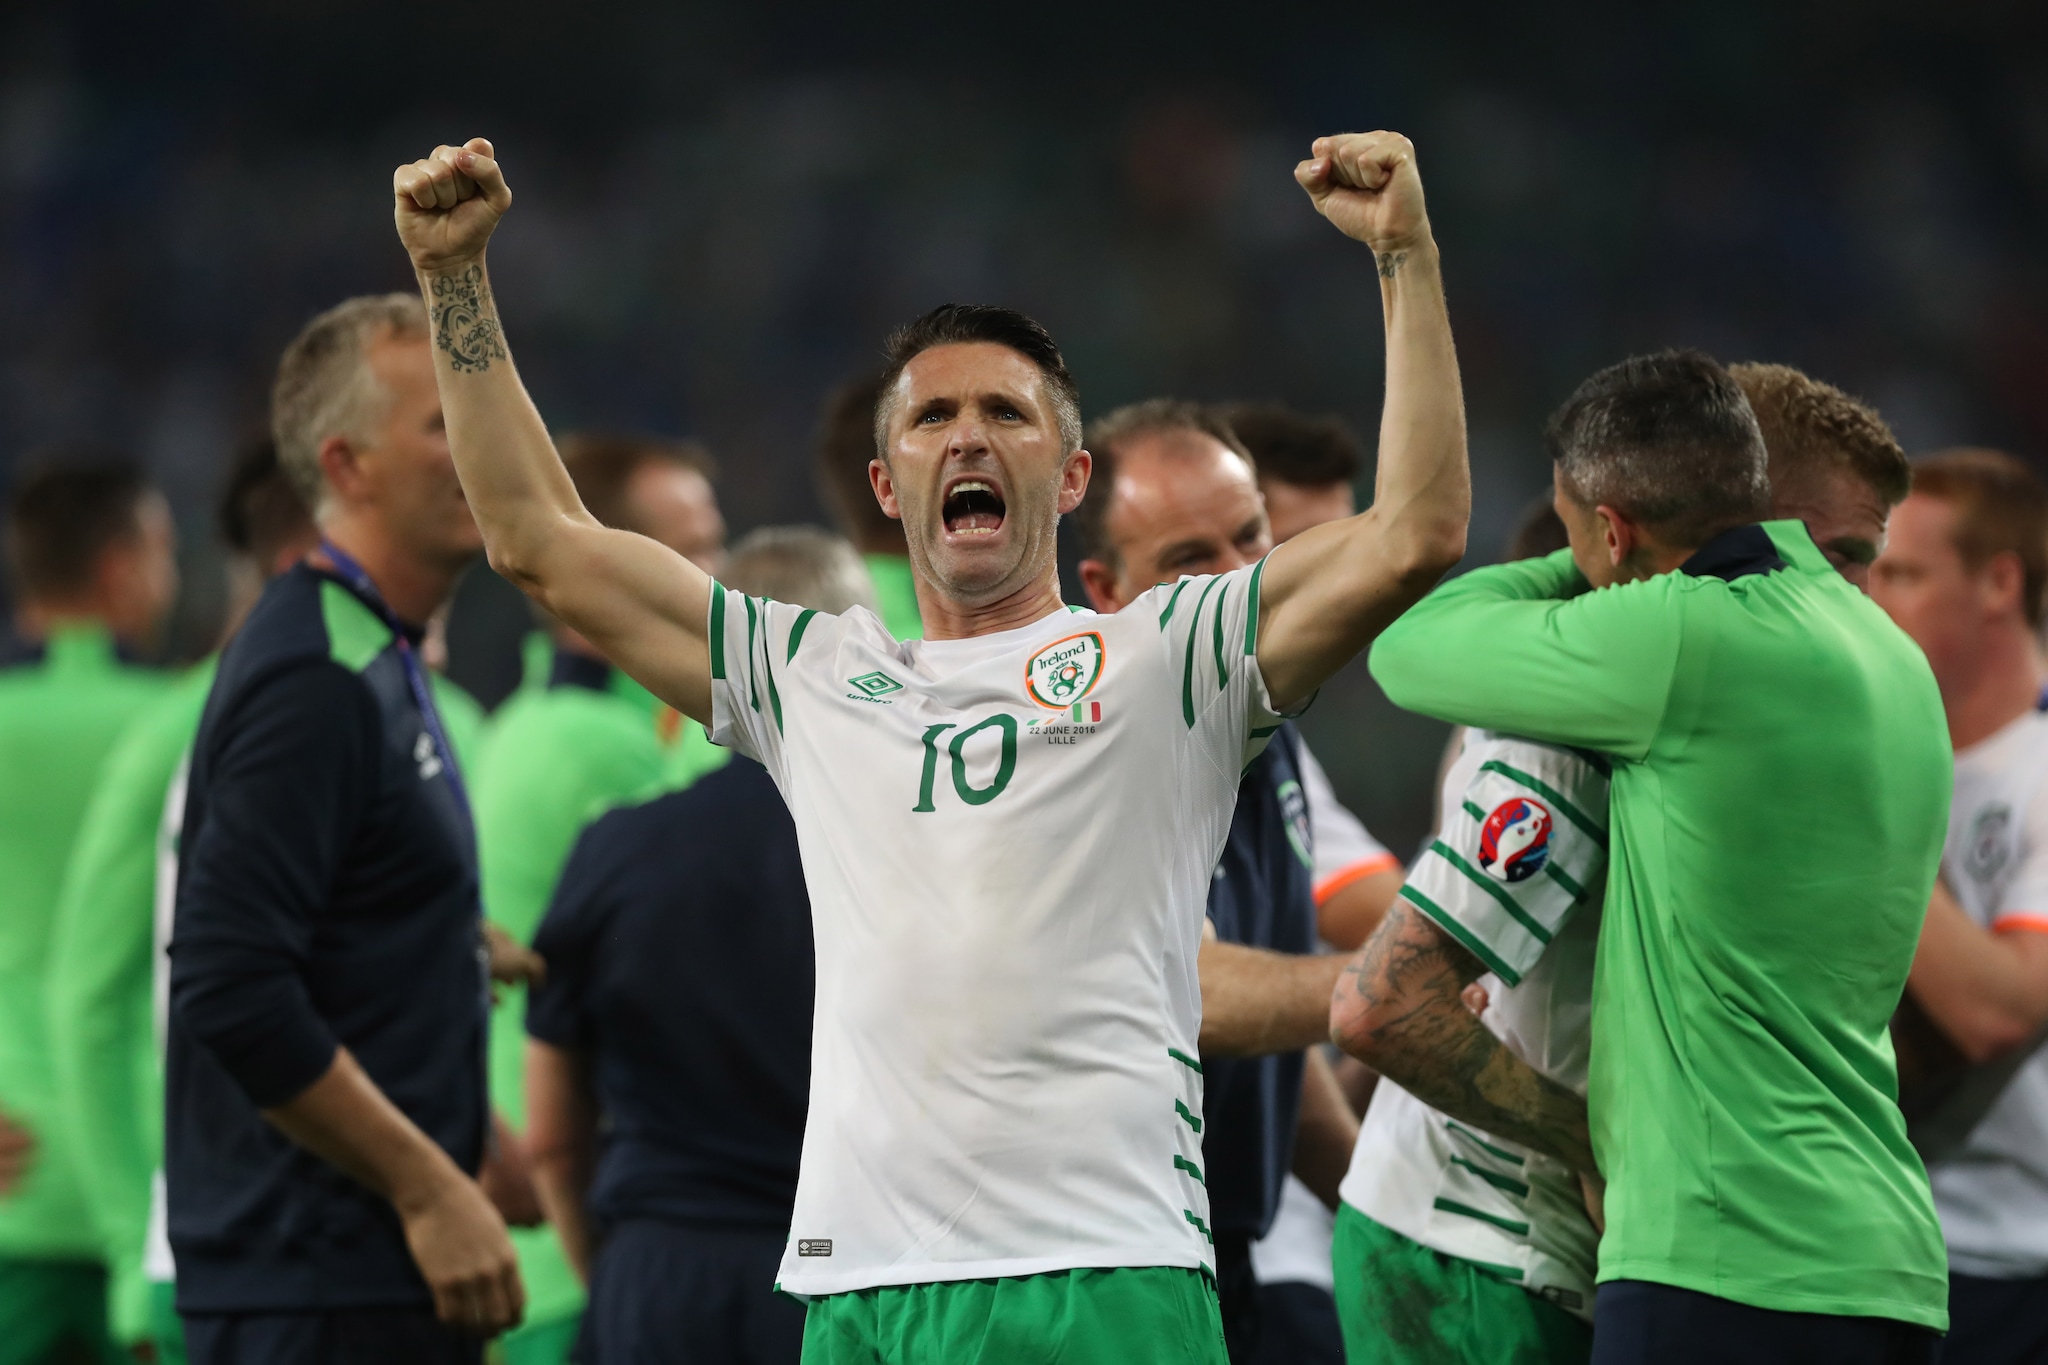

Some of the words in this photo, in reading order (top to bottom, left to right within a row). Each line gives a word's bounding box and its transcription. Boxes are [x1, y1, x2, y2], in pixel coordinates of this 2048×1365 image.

[1038, 641, 1085, 669] Ireland
[846, 693, 893, 704] umbro
[1029, 727, 1040, 735] 22
[1043, 726, 1070, 735] JUNE
[1073, 726, 1096, 735] 2016
[1048, 736, 1076, 745] LILLE
[912, 713, 1017, 812] 10
